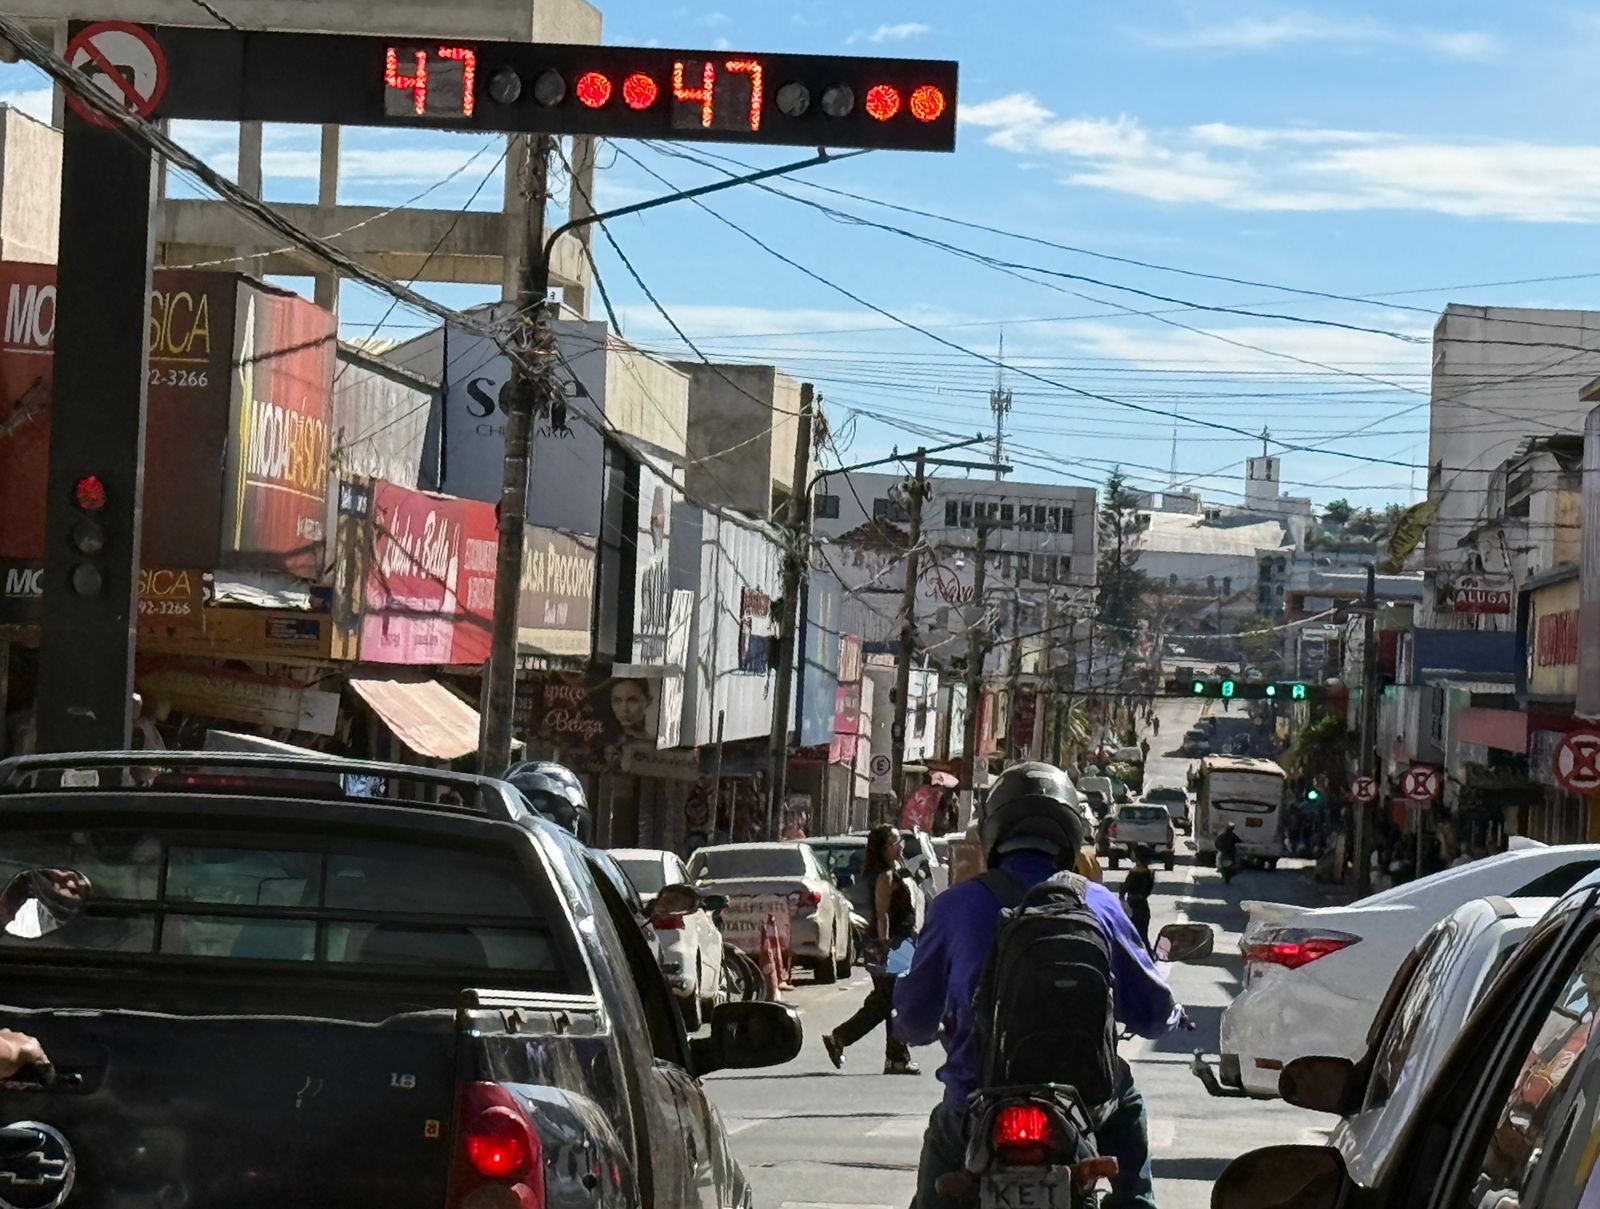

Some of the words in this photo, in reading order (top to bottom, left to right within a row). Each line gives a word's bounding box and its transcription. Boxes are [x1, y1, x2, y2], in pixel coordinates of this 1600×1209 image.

[384, 47, 475, 118] 47
[673, 60, 763, 132] 47
[4, 283, 57, 347] MO
[148, 290, 211, 354] SICA
[1456, 590, 1508, 605] ALUGA
